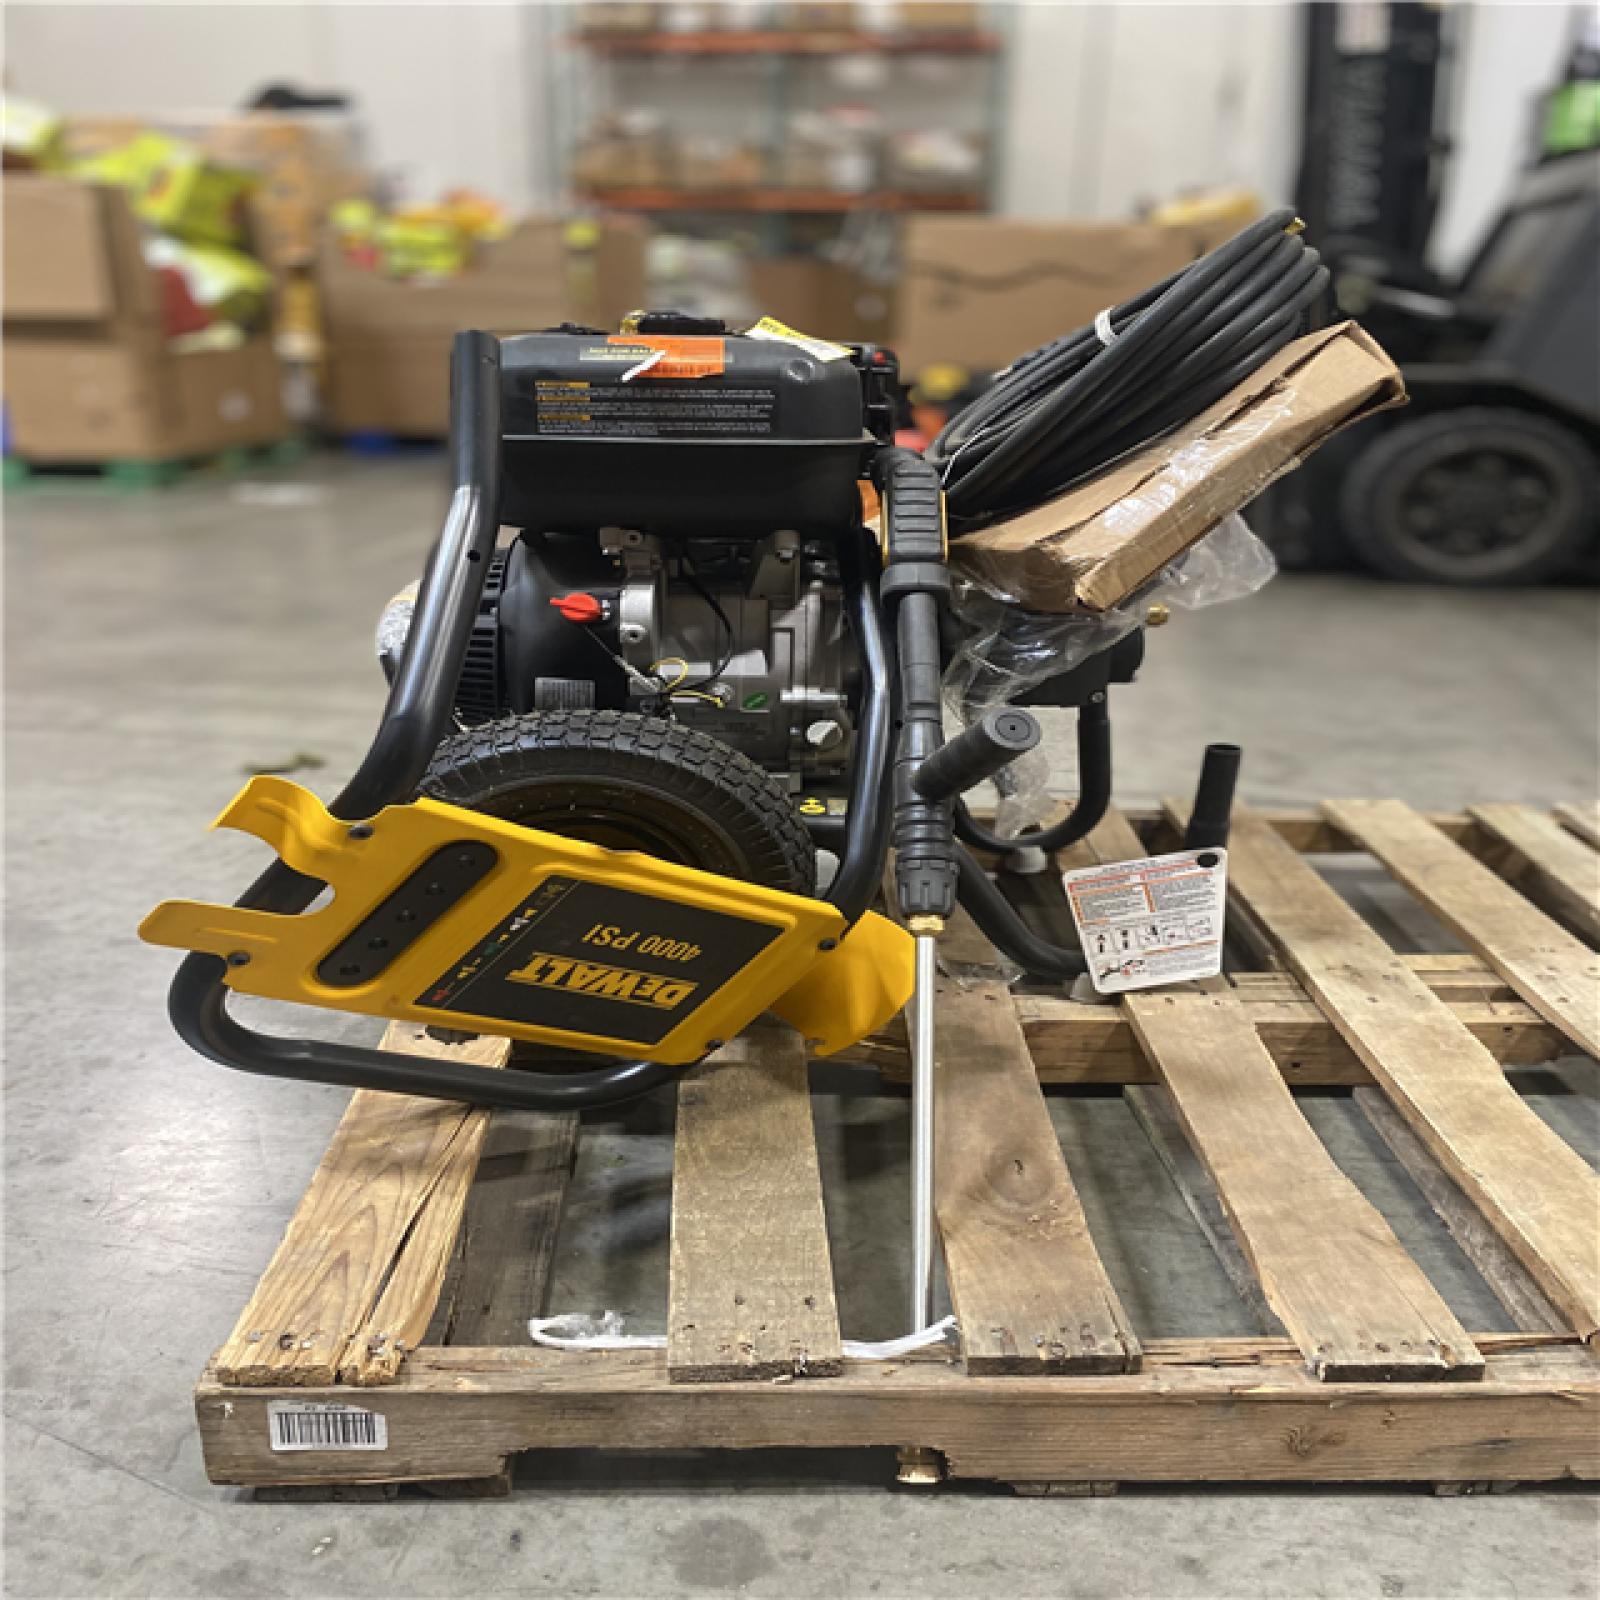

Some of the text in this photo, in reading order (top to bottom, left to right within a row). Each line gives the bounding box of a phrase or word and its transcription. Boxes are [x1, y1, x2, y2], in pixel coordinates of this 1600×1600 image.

[581, 923, 702, 961] 4000 PSI
[504, 951, 699, 1010] DEWALT
